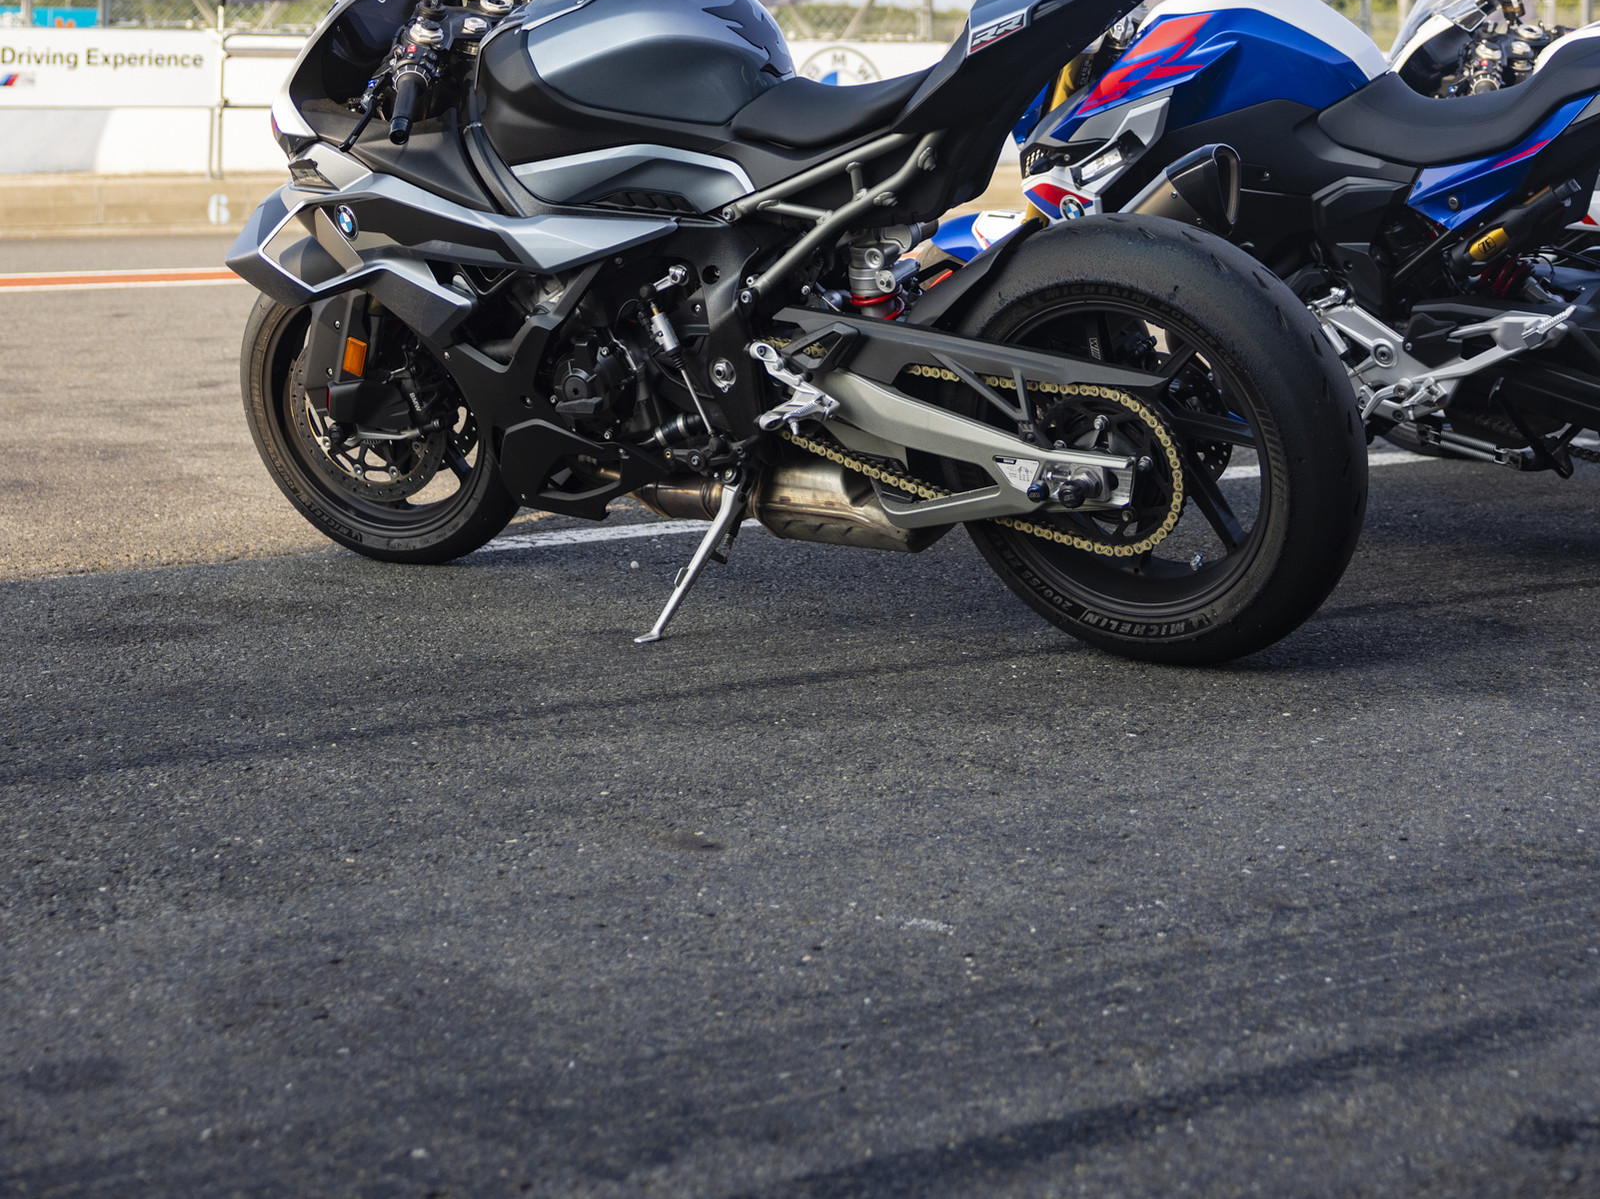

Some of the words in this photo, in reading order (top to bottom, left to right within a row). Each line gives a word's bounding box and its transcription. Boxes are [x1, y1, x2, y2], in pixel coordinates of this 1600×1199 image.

[1, 47, 79, 70] Driving
[86, 48, 204, 69] Experience
[207, 193, 231, 225] 6
[1046, 284, 1146, 303] MICHELIN
[1158, 304, 1215, 351] POWER
[409, 392, 422, 411] BMW
[1021, 568, 1073, 612] 200/55
[1082, 611, 1186, 637] MICHELIN
